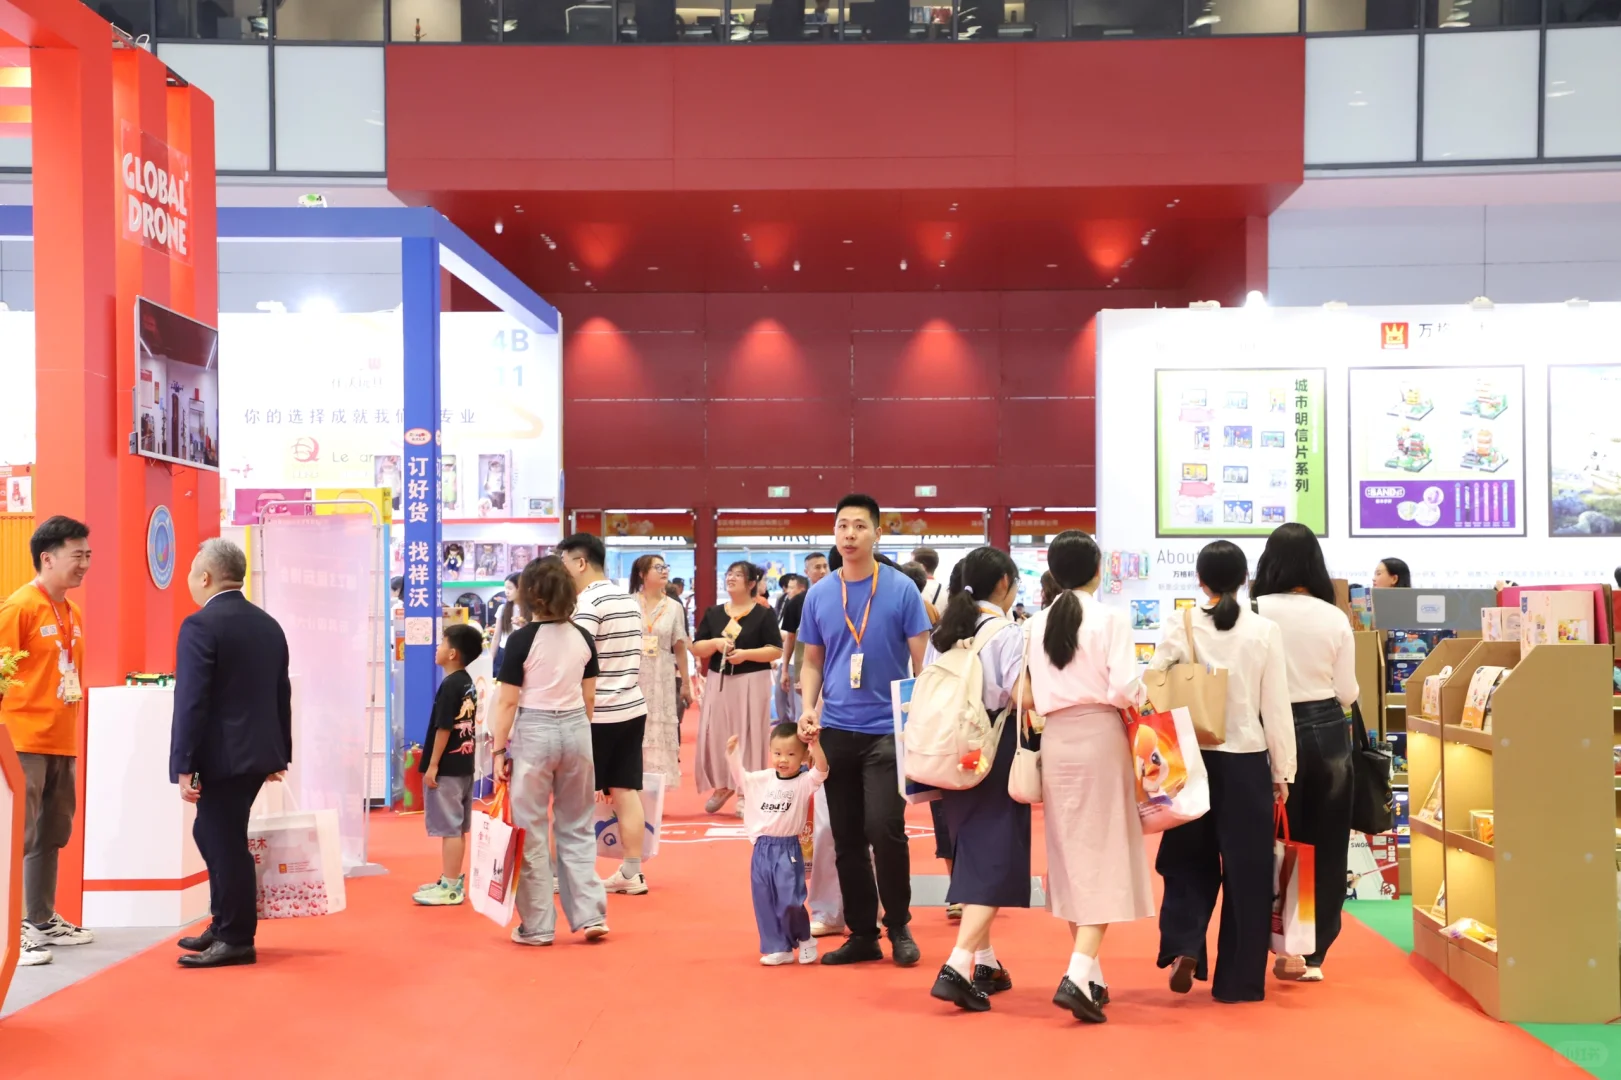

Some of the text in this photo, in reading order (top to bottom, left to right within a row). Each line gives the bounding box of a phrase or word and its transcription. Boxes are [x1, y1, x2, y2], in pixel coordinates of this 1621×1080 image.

[122, 152, 188, 216] GLOBAL
[128, 194, 187, 255] DRONE
[1295, 378, 1310, 493] 城市明信片系列
[408, 456, 429, 523] 订好货
[1156, 549, 1200, 565] Abou
